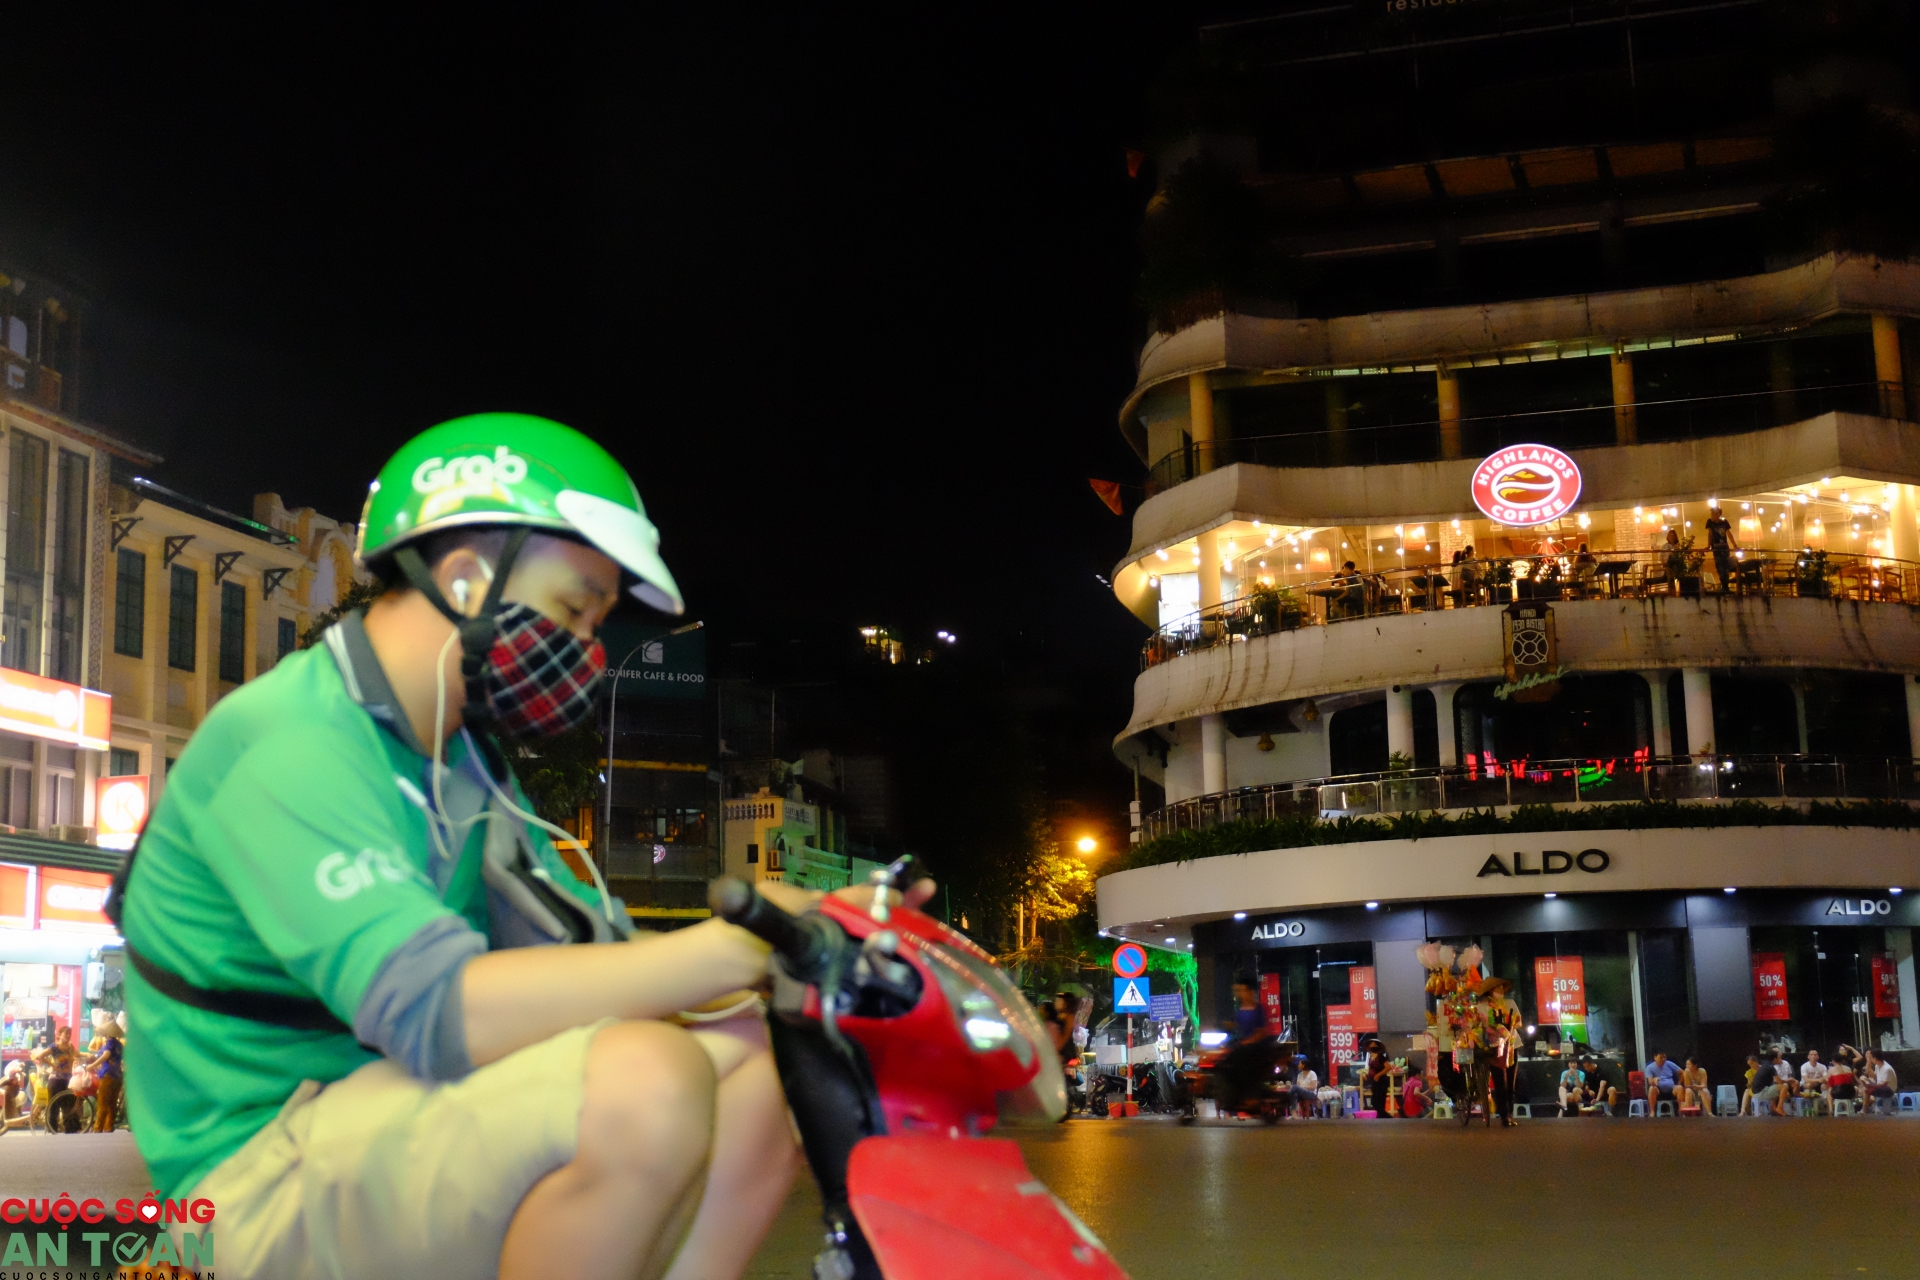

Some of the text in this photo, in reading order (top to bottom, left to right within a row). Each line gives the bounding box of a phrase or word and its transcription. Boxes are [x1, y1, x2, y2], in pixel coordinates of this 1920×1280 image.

[411, 445, 528, 495] Grab
[1477, 449, 1574, 487] HIGHLANDS
[1491, 498, 1566, 522] COFFEE
[1512, 618, 1545, 632] 1930 BISTRO
[643, 670, 666, 681] CAFE
[667, 672, 675, 682] &
[677, 673, 704, 683] FOOD
[1476, 848, 1611, 878] ALDO
[1825, 899, 1892, 916] ALDO
[1251, 922, 1304, 940] ALDO
[1553, 979, 1580, 992] 50%
[1759, 974, 1783, 987] 50%
[1363, 988, 1375, 1001] 50
[1562, 993, 1572, 1001] off
[1560, 1003, 1581, 1011] iginal
